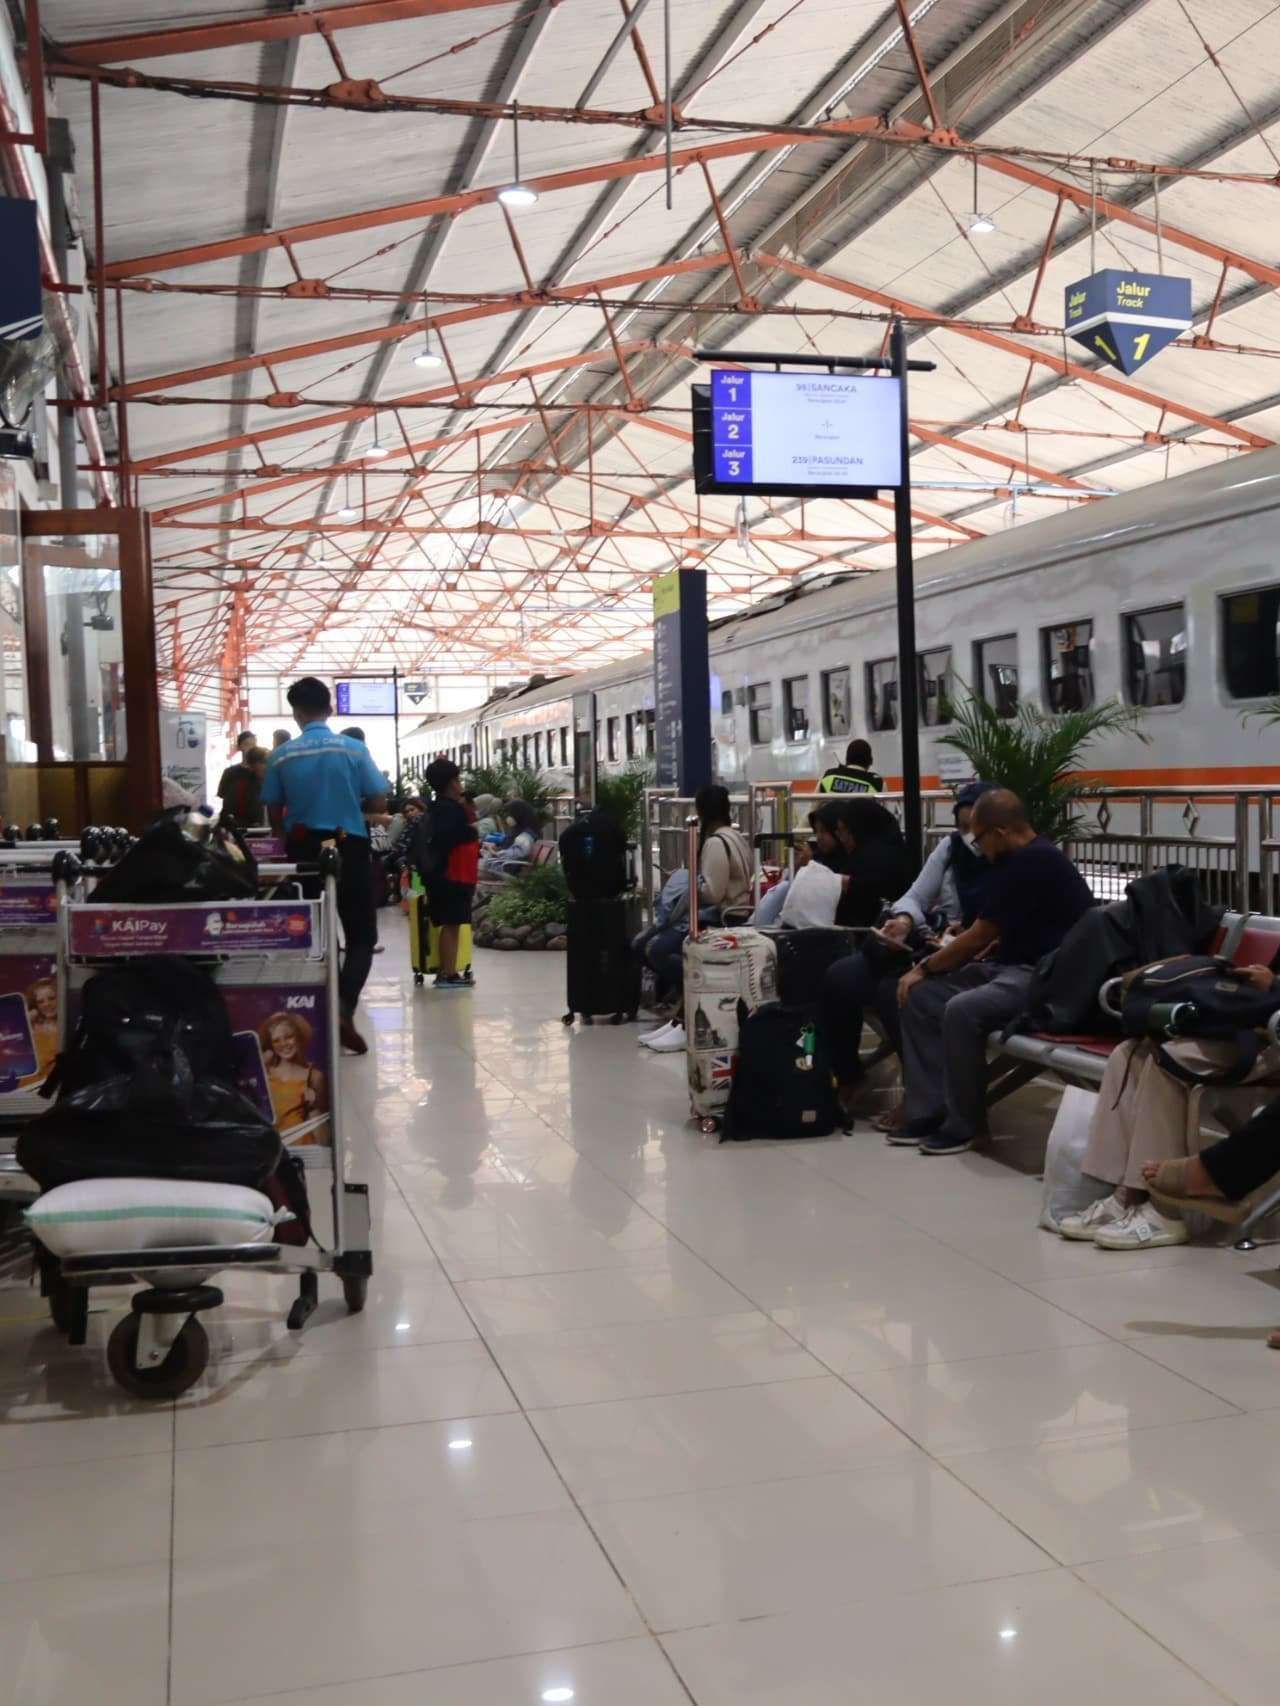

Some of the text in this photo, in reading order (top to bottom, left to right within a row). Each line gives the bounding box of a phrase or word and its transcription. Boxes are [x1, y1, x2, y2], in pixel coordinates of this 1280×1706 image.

[1116, 281, 1151, 297] Jalur
[1116, 295, 1144, 308] Track
[1094, 335, 1117, 360] 1
[1133, 333, 1151, 360] 1
[720, 375, 744, 385] Jalur
[728, 387, 737, 402] 1
[721, 412, 745, 422] Jalur
[727, 424, 739, 439] 2
[722, 449, 746, 459] Jalur
[728, 461, 740, 476] 3
[111, 917, 168, 934] KAIPay
[286, 995, 316, 1009] KAI
